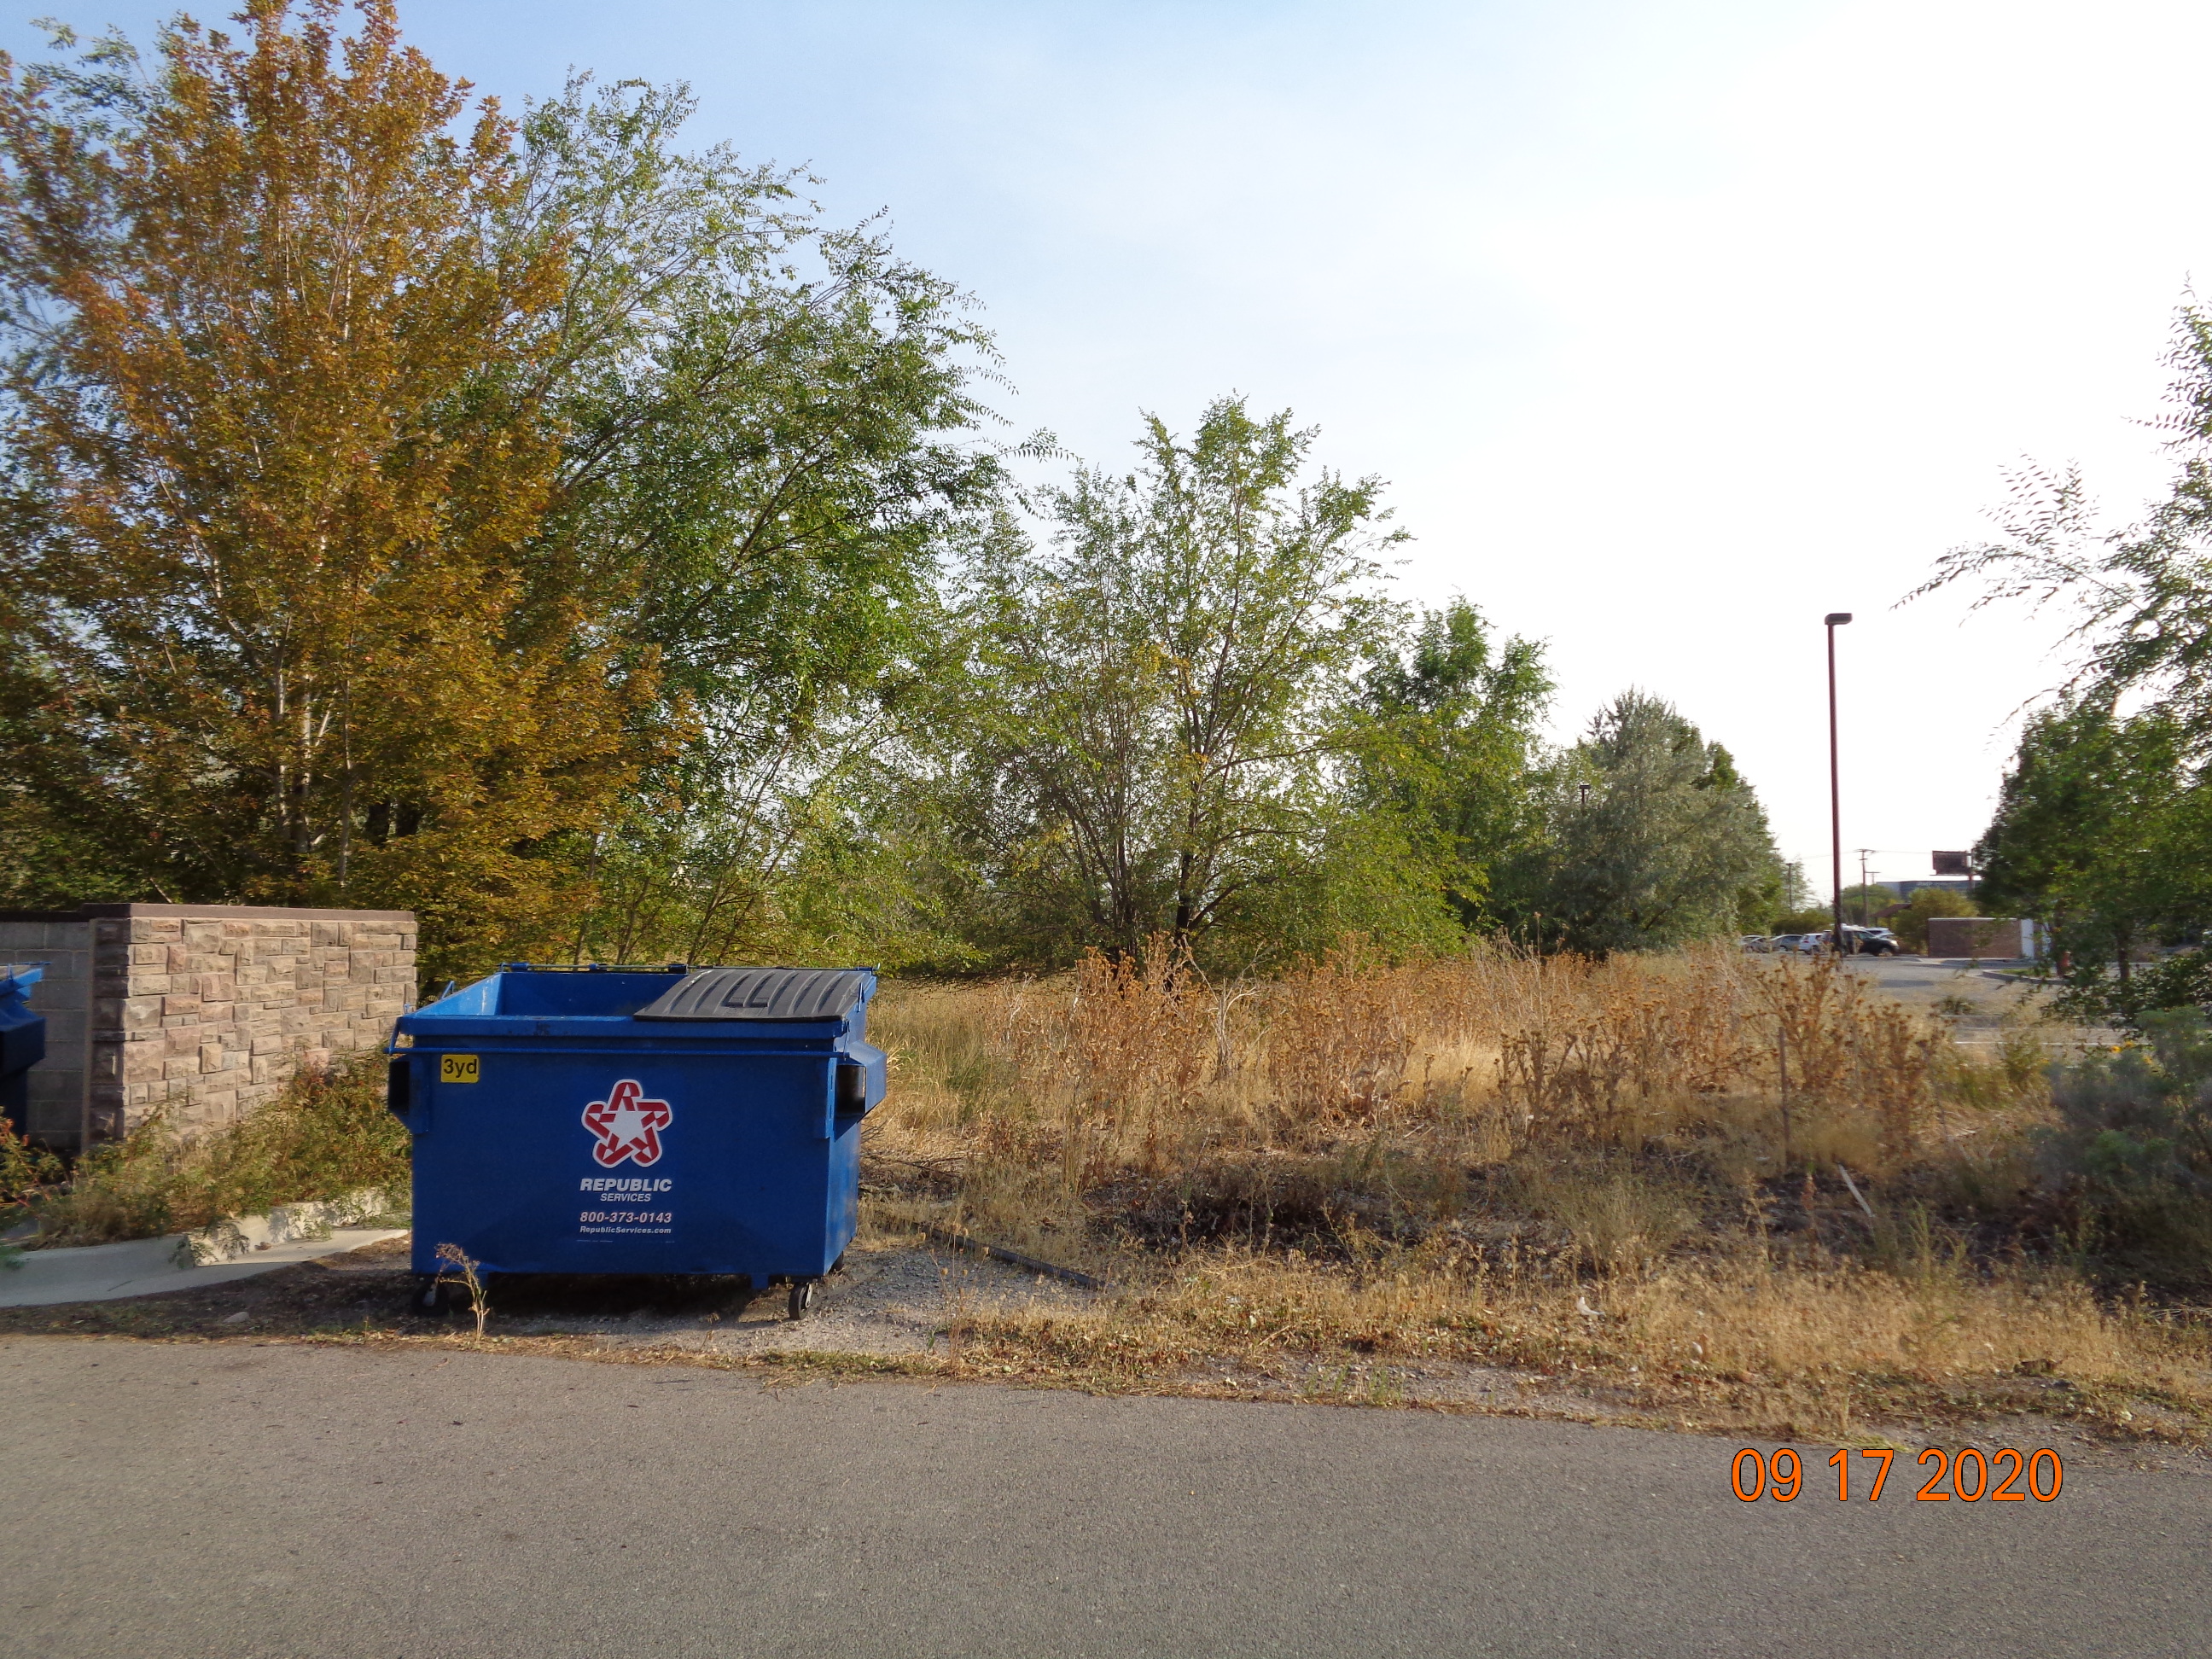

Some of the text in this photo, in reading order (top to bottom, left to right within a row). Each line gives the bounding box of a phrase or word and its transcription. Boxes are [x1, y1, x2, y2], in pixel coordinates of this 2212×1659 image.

[444, 1058, 477, 1079] 3yd
[579, 1178, 672, 1192] REPUBLIC
[600, 1193, 652, 1202] SERVICES
[579, 1211, 672, 1223] 800-373-0143
[579, 1225, 672, 1234] RepublicServices.com
